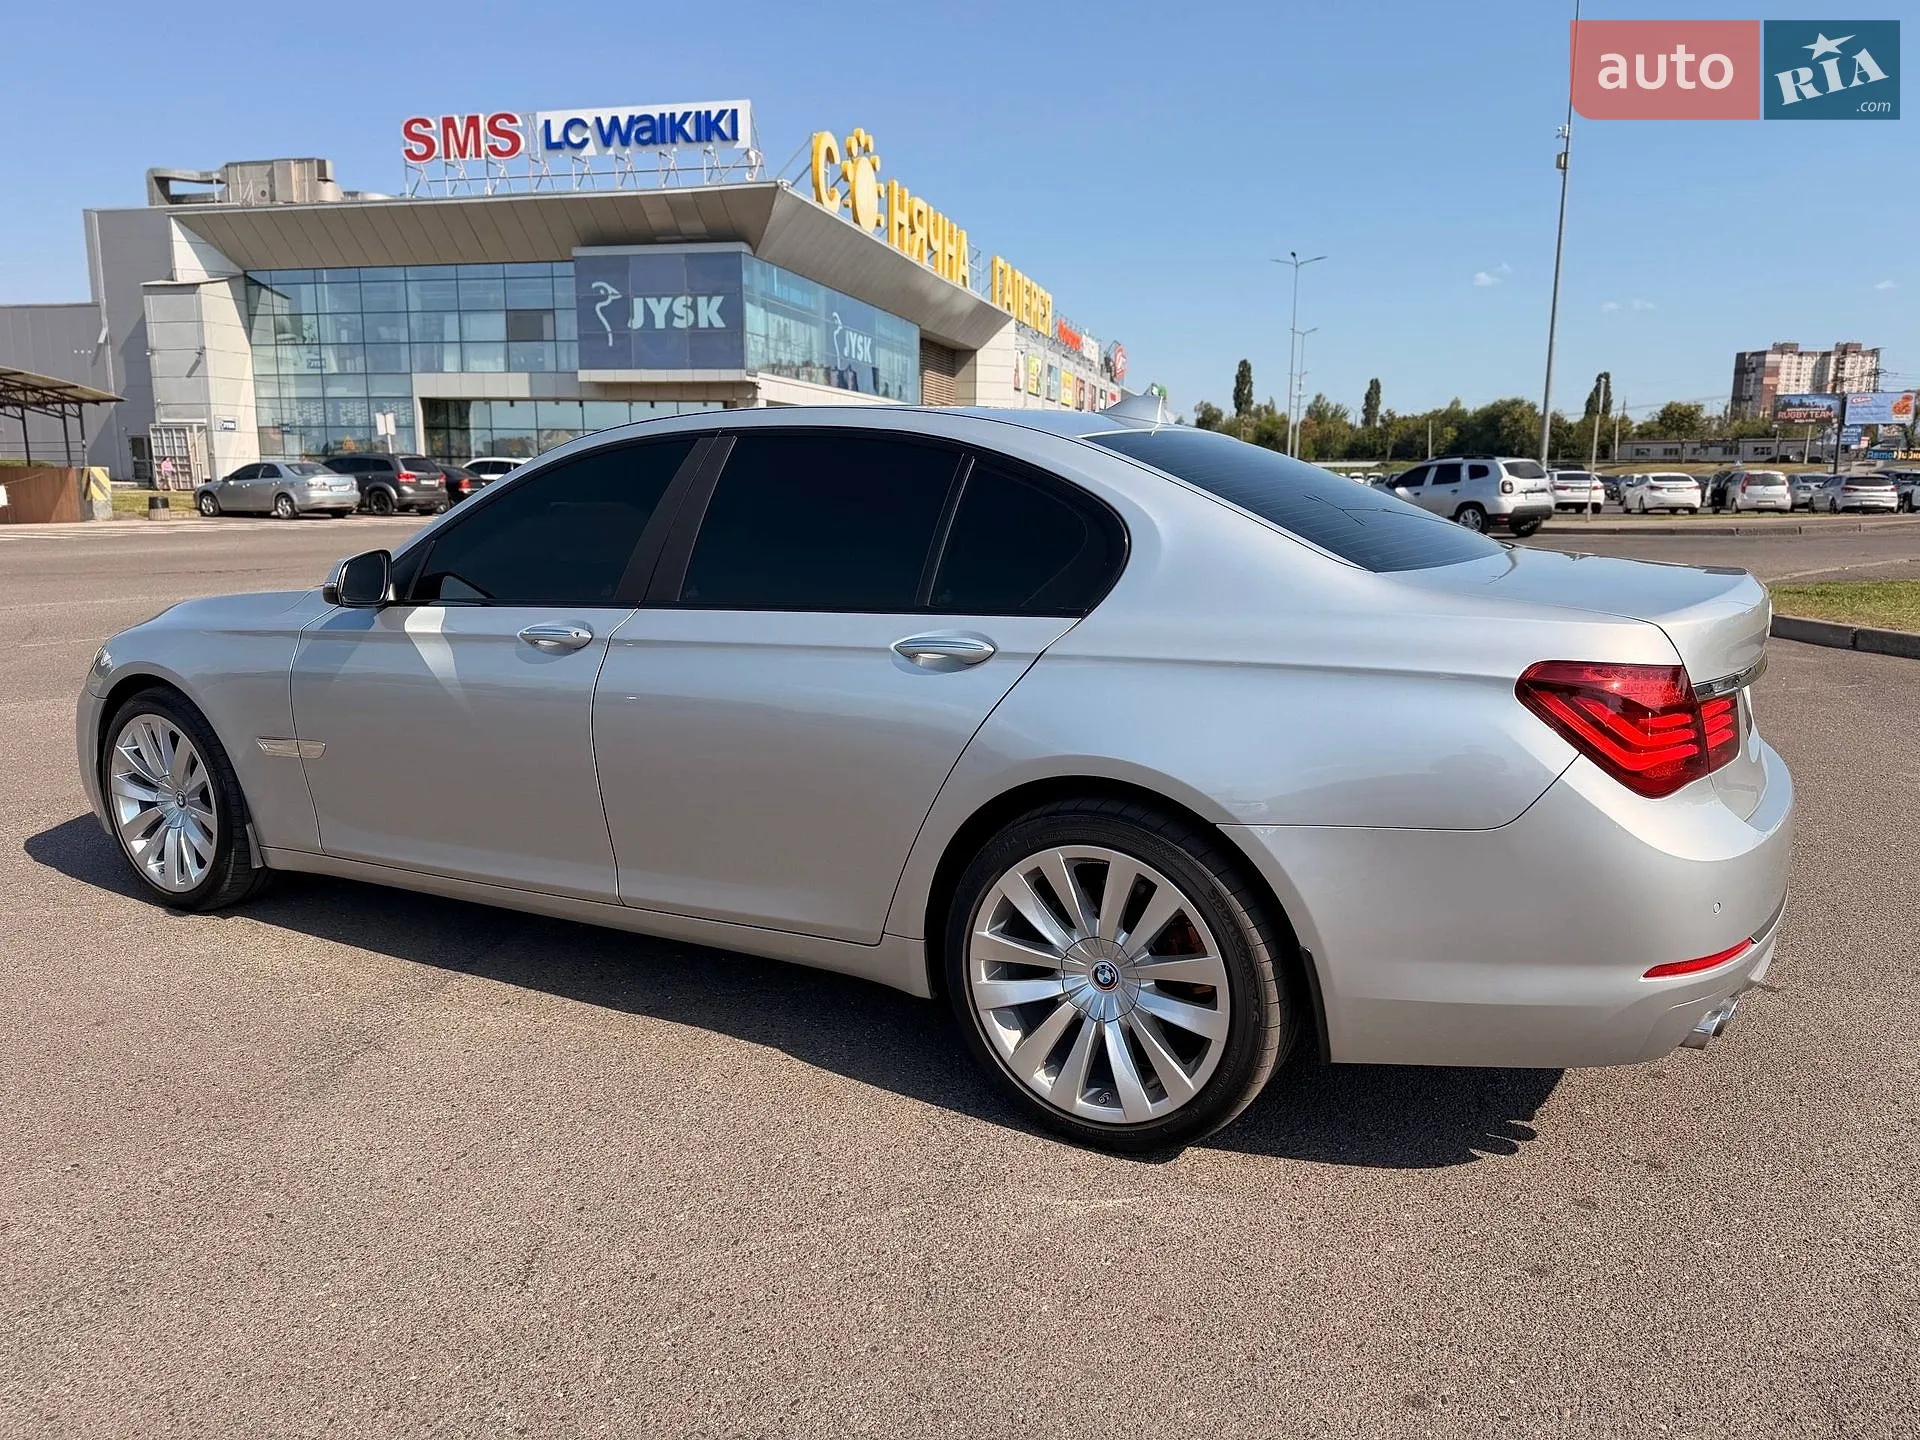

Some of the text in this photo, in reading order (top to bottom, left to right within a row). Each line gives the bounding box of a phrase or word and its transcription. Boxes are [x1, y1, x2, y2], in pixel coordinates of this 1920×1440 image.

[403, 112, 523, 163] SMS
[544, 116, 589, 150] LC
[628, 295, 726, 329] JYSK
[843, 336, 873, 364] JYSK
[1777, 410, 1834, 420] RUGBY TEAM
